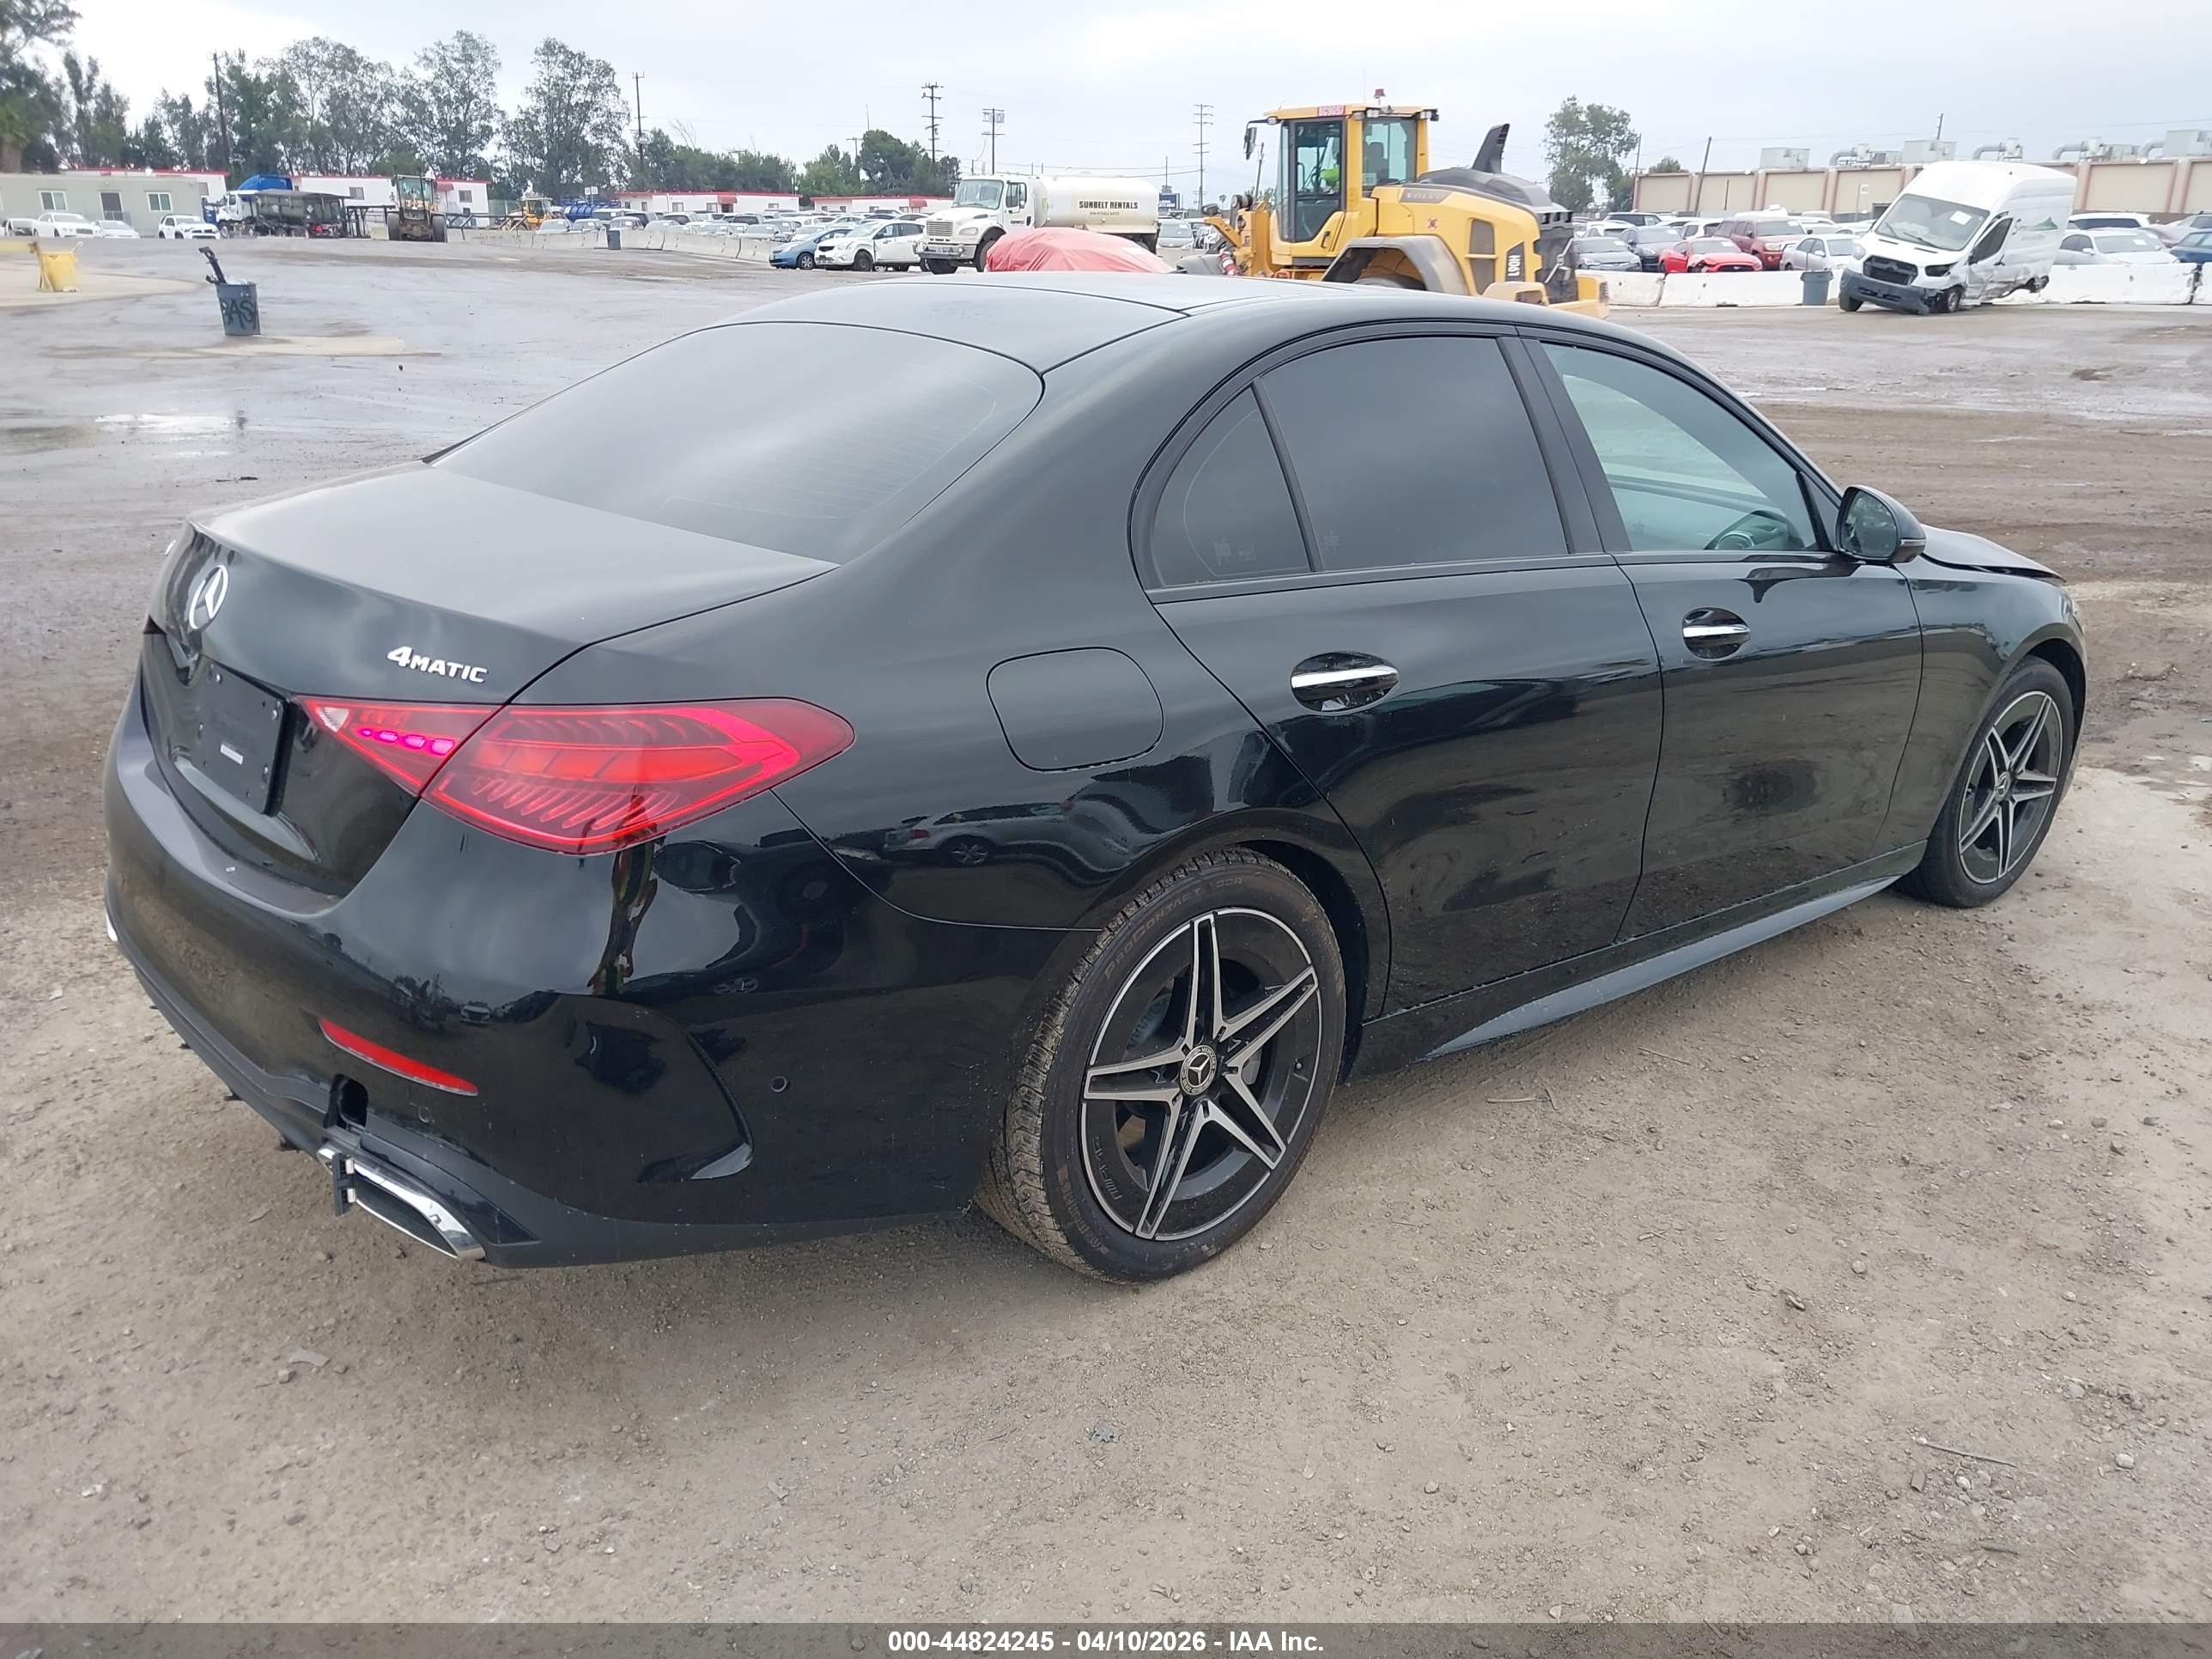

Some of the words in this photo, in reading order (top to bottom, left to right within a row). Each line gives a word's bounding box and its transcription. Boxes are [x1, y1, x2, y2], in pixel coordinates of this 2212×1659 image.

[1079, 200, 1109, 210] SUNBELT
[1109, 201, 1139, 210] RENTALS
[1508, 254, 1521, 276] L90H
[386, 646, 489, 684] 4MATIC
